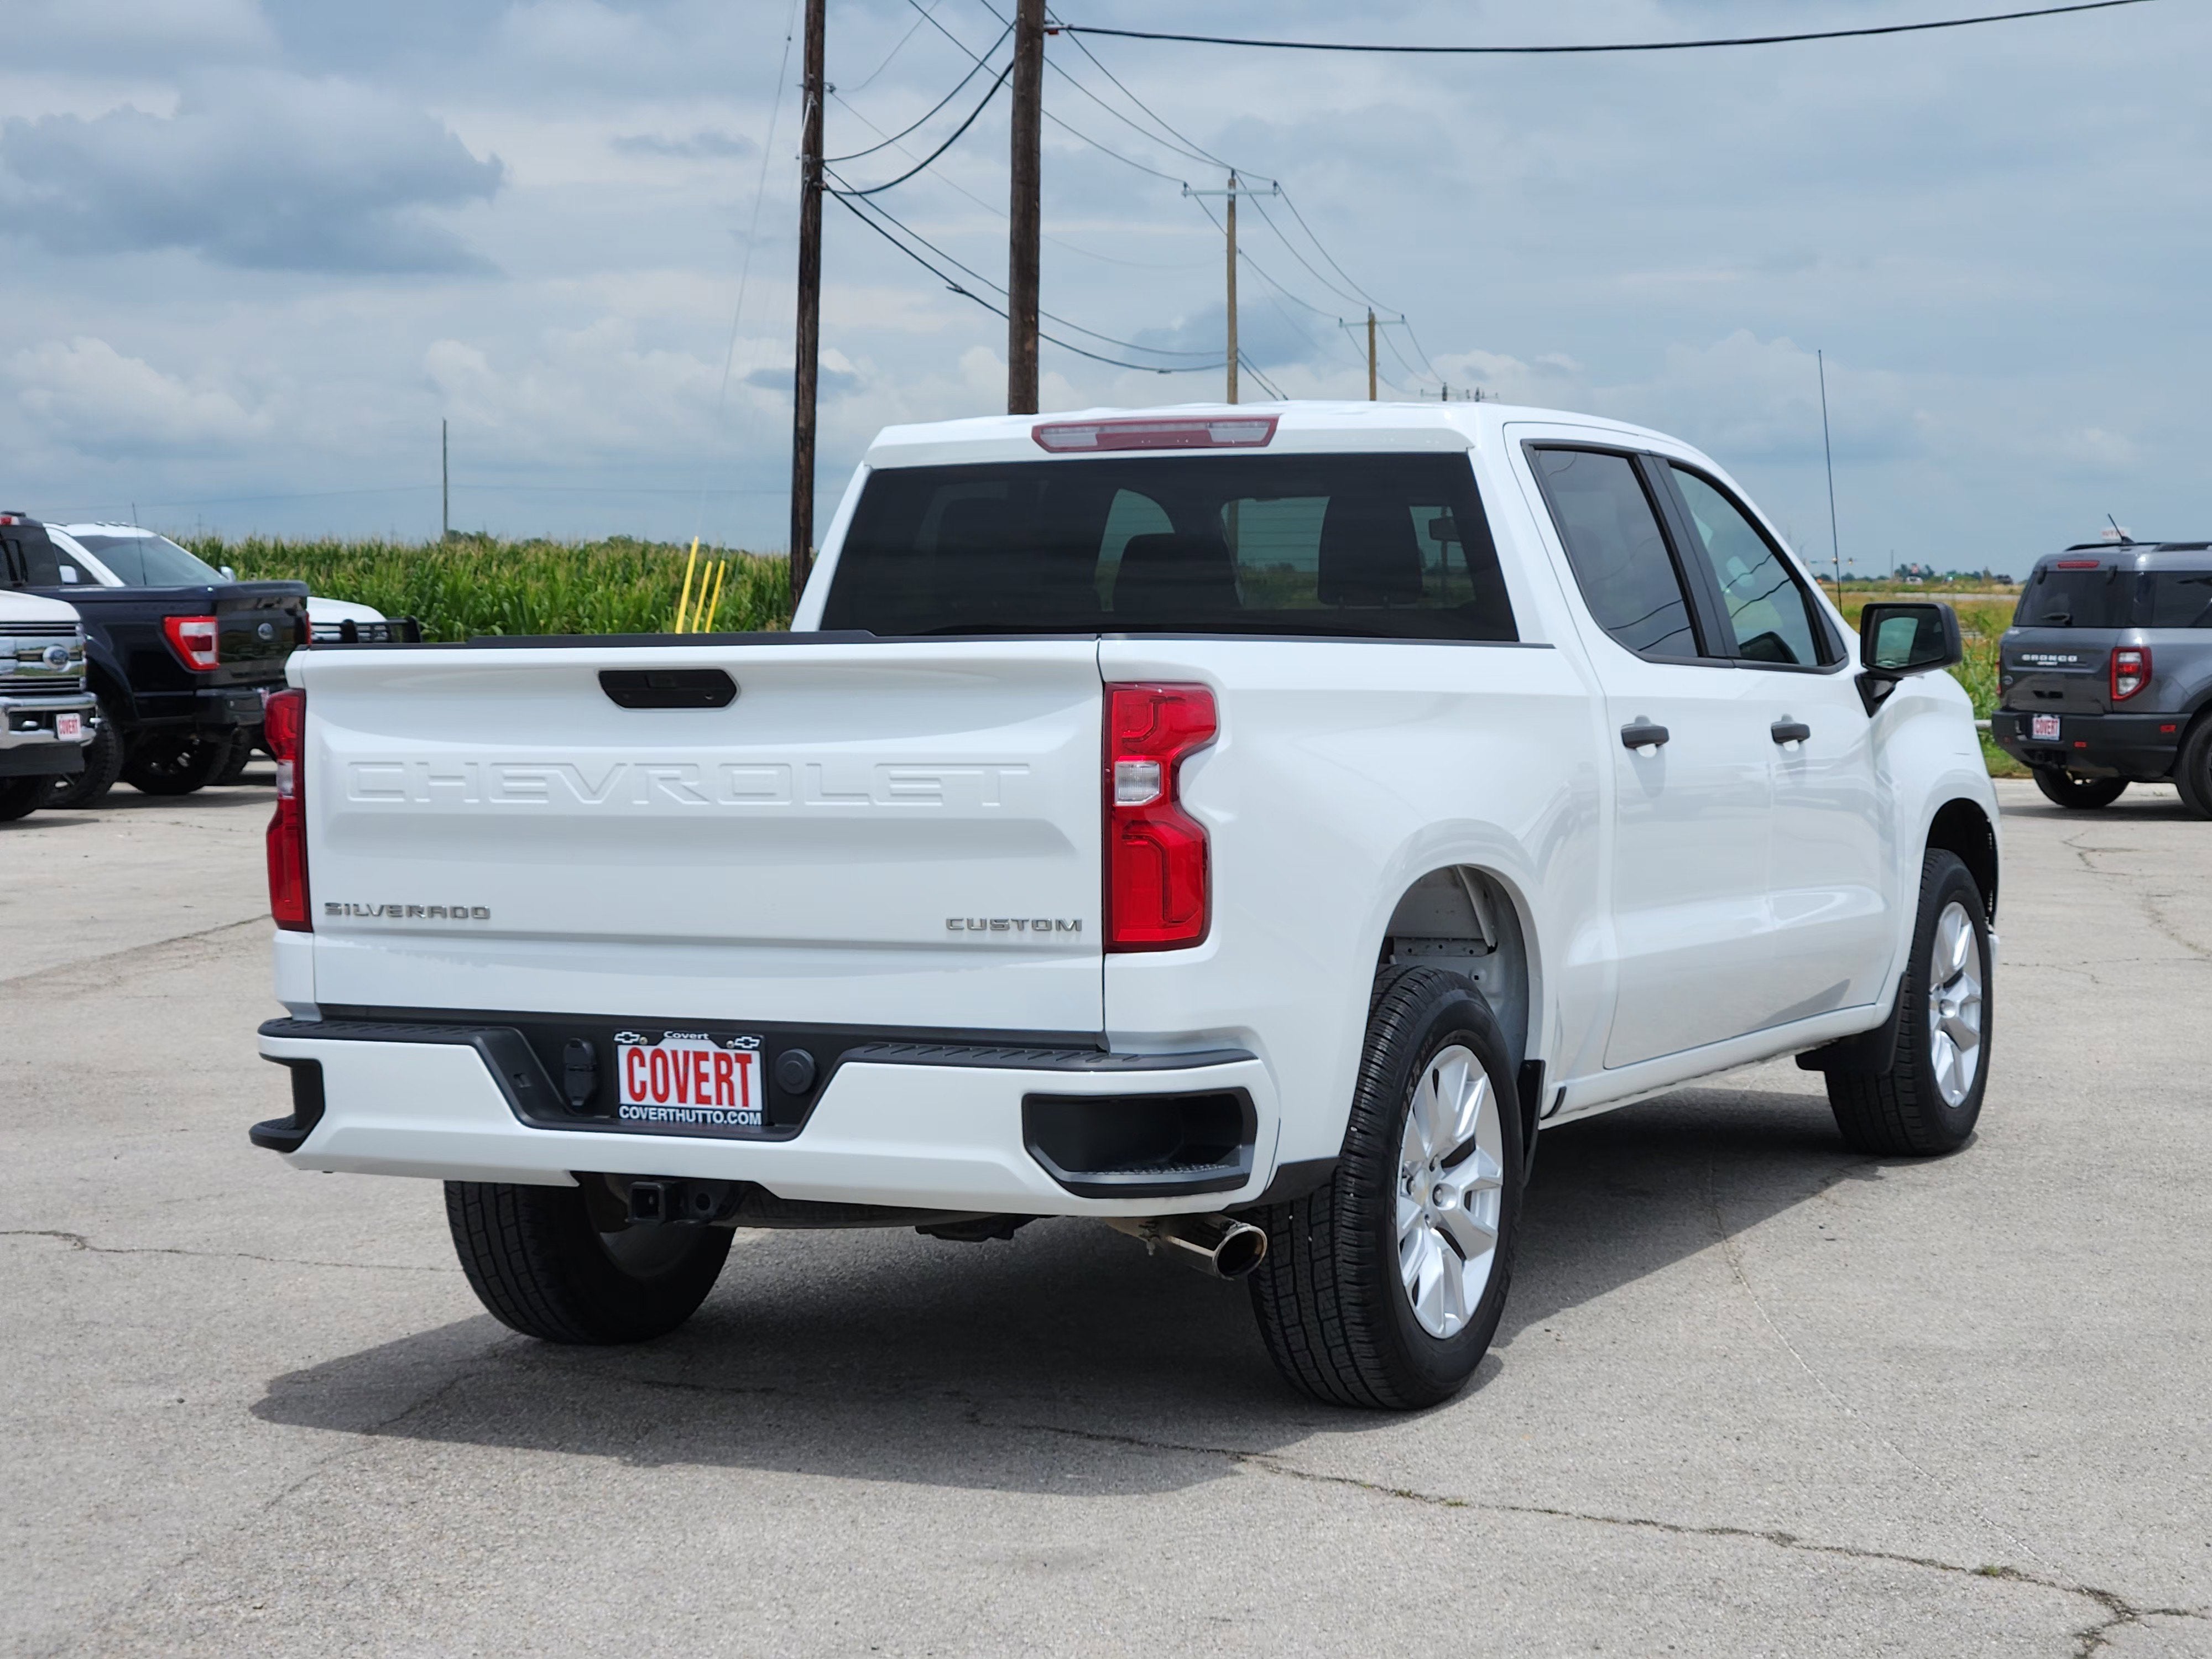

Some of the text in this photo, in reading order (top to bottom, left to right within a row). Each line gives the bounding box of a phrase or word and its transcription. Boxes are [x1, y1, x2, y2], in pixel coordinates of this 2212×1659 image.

[59, 719, 78, 734] COVERT
[2036, 719, 2058, 734] COVERT
[348, 761, 1030, 807] CHEVROLET
[324, 902, 491, 919] SILVERADO
[946, 918, 1082, 932] CUSTOM
[664, 1030, 709, 1040] Covert
[627, 1047, 753, 1108] COVERT
[619, 1105, 762, 1125] COVERTHUTTO.COM
